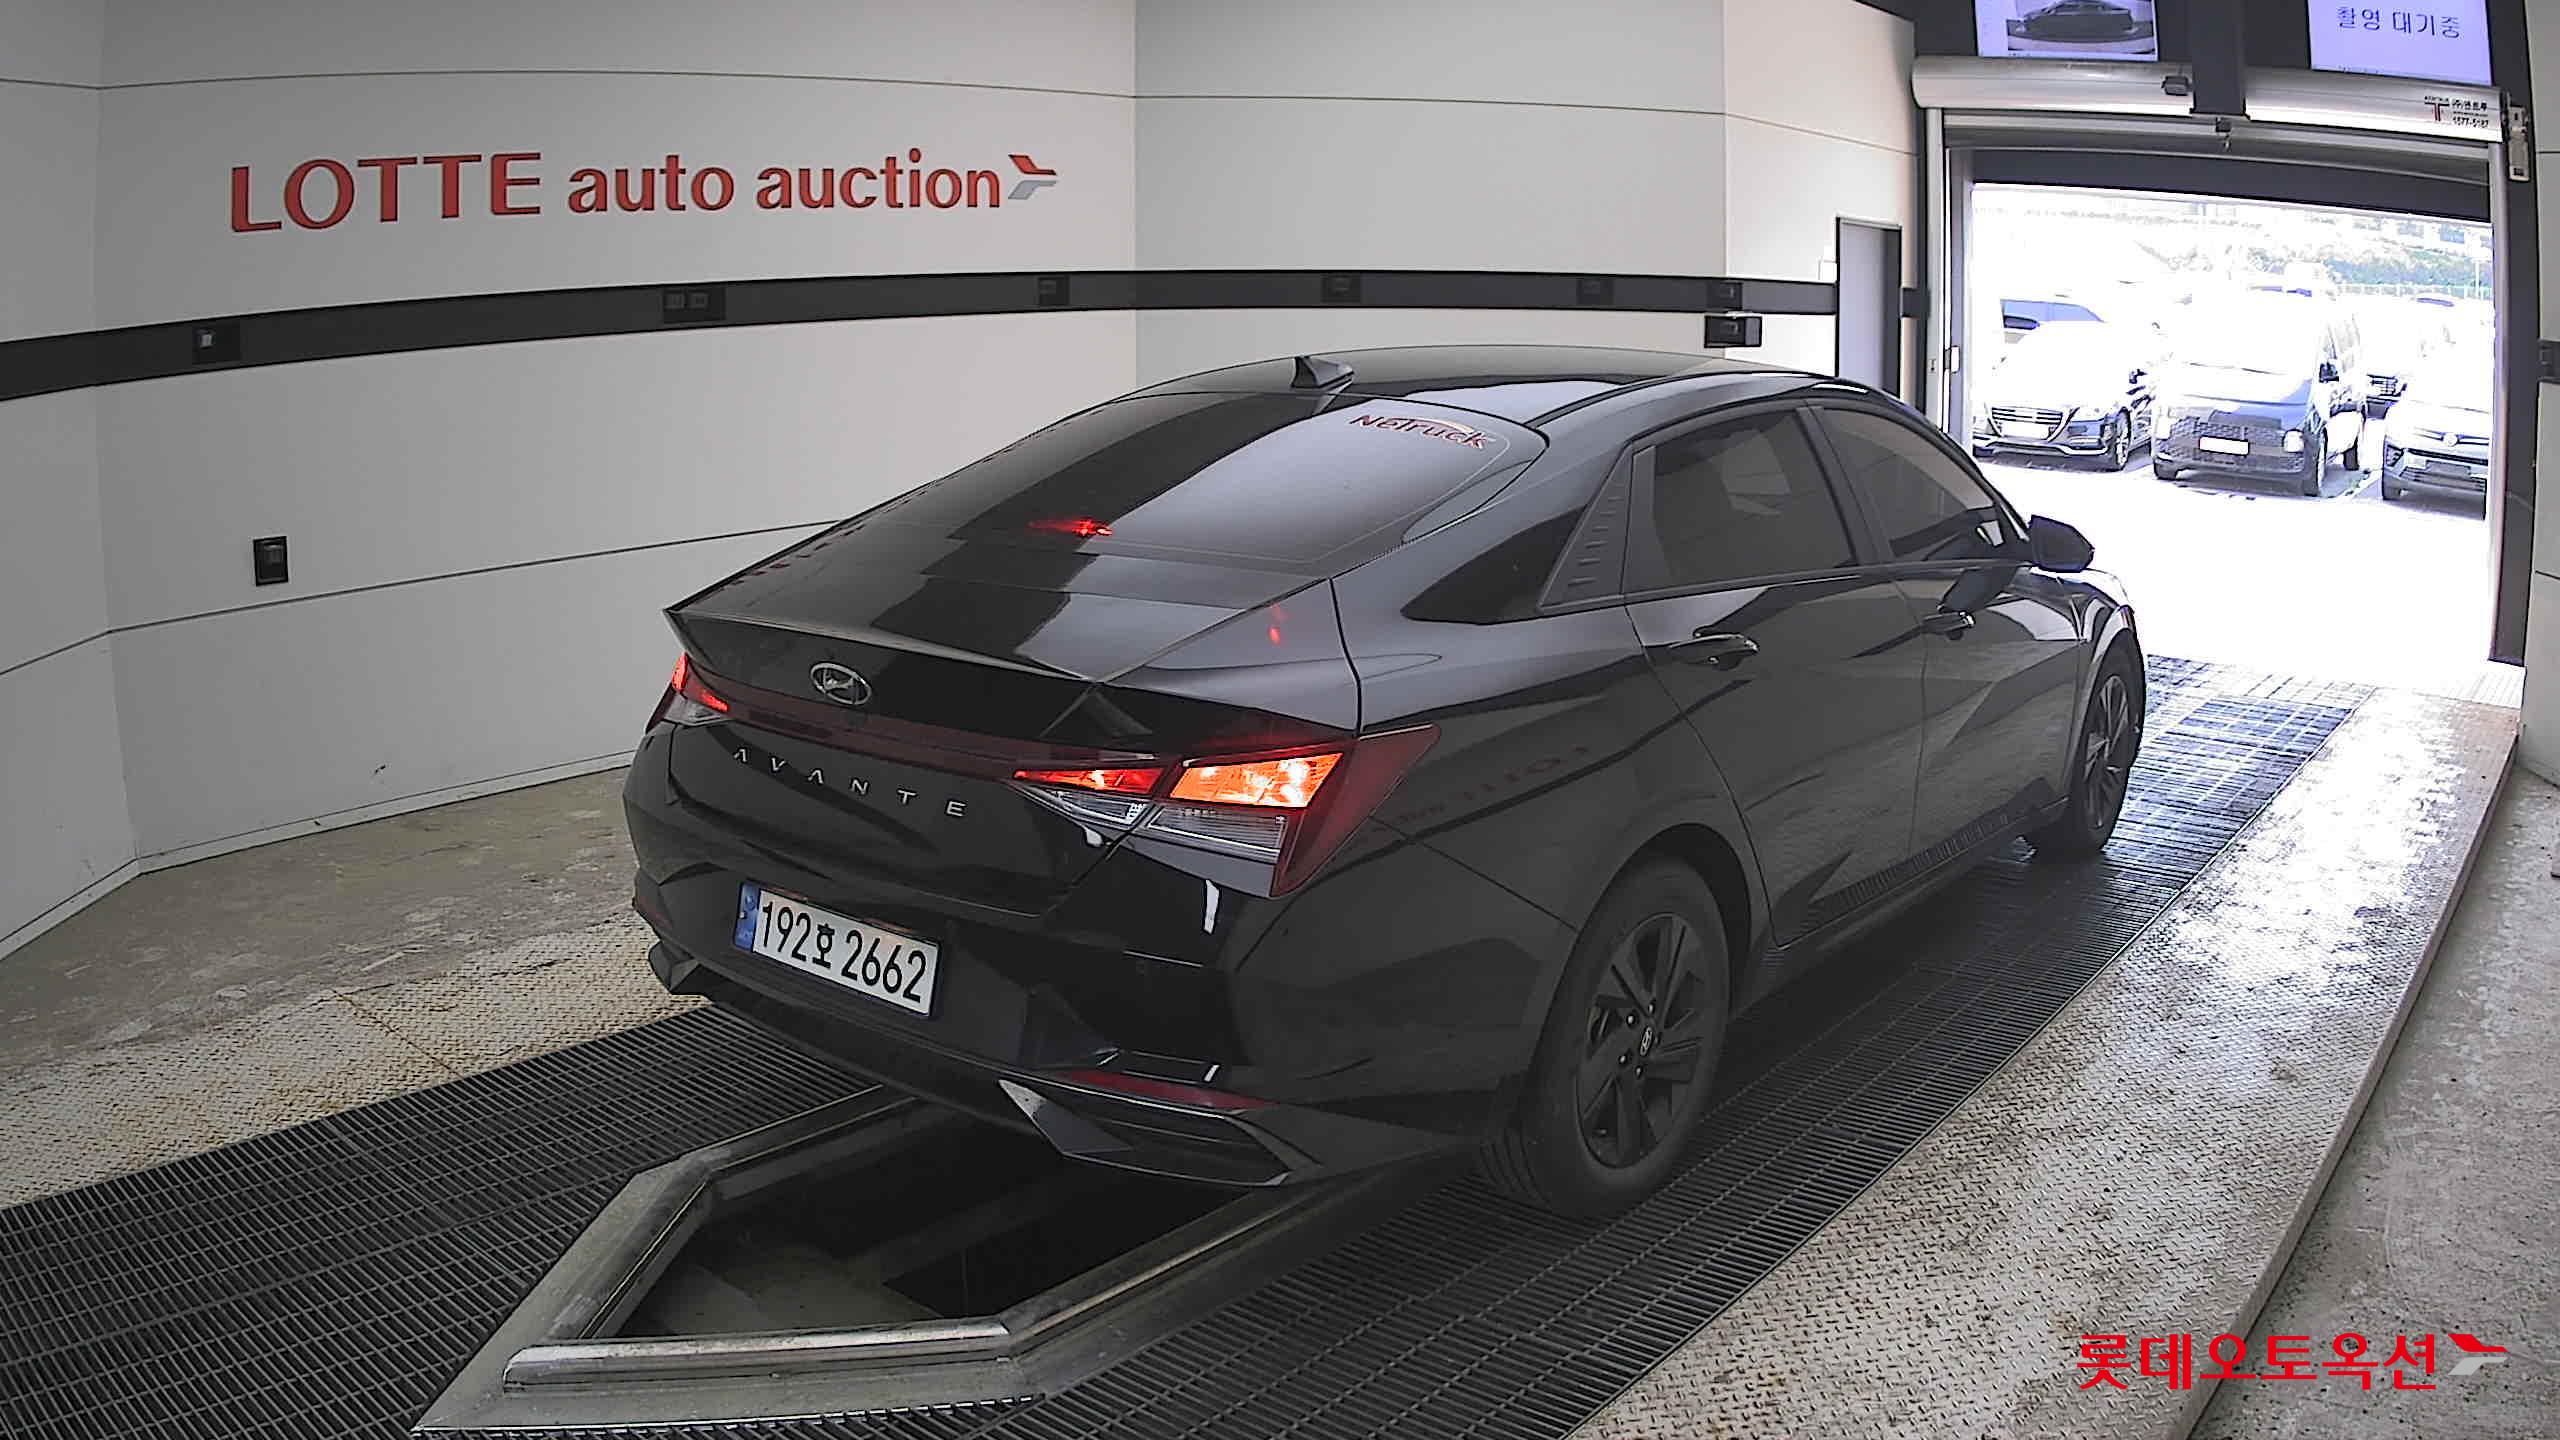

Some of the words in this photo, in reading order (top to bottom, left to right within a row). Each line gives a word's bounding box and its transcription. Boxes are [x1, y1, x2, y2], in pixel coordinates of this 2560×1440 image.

[2337, 7, 2381, 31] 촬영
[2392, 11, 2460, 39] 대기중
[230, 151, 542, 233] LOTTE
[567, 153, 736, 214] auto
[755, 147, 1002, 210] auction
[733, 747, 967, 817] AVANTE
[840, 929, 927, 1004] 2662
